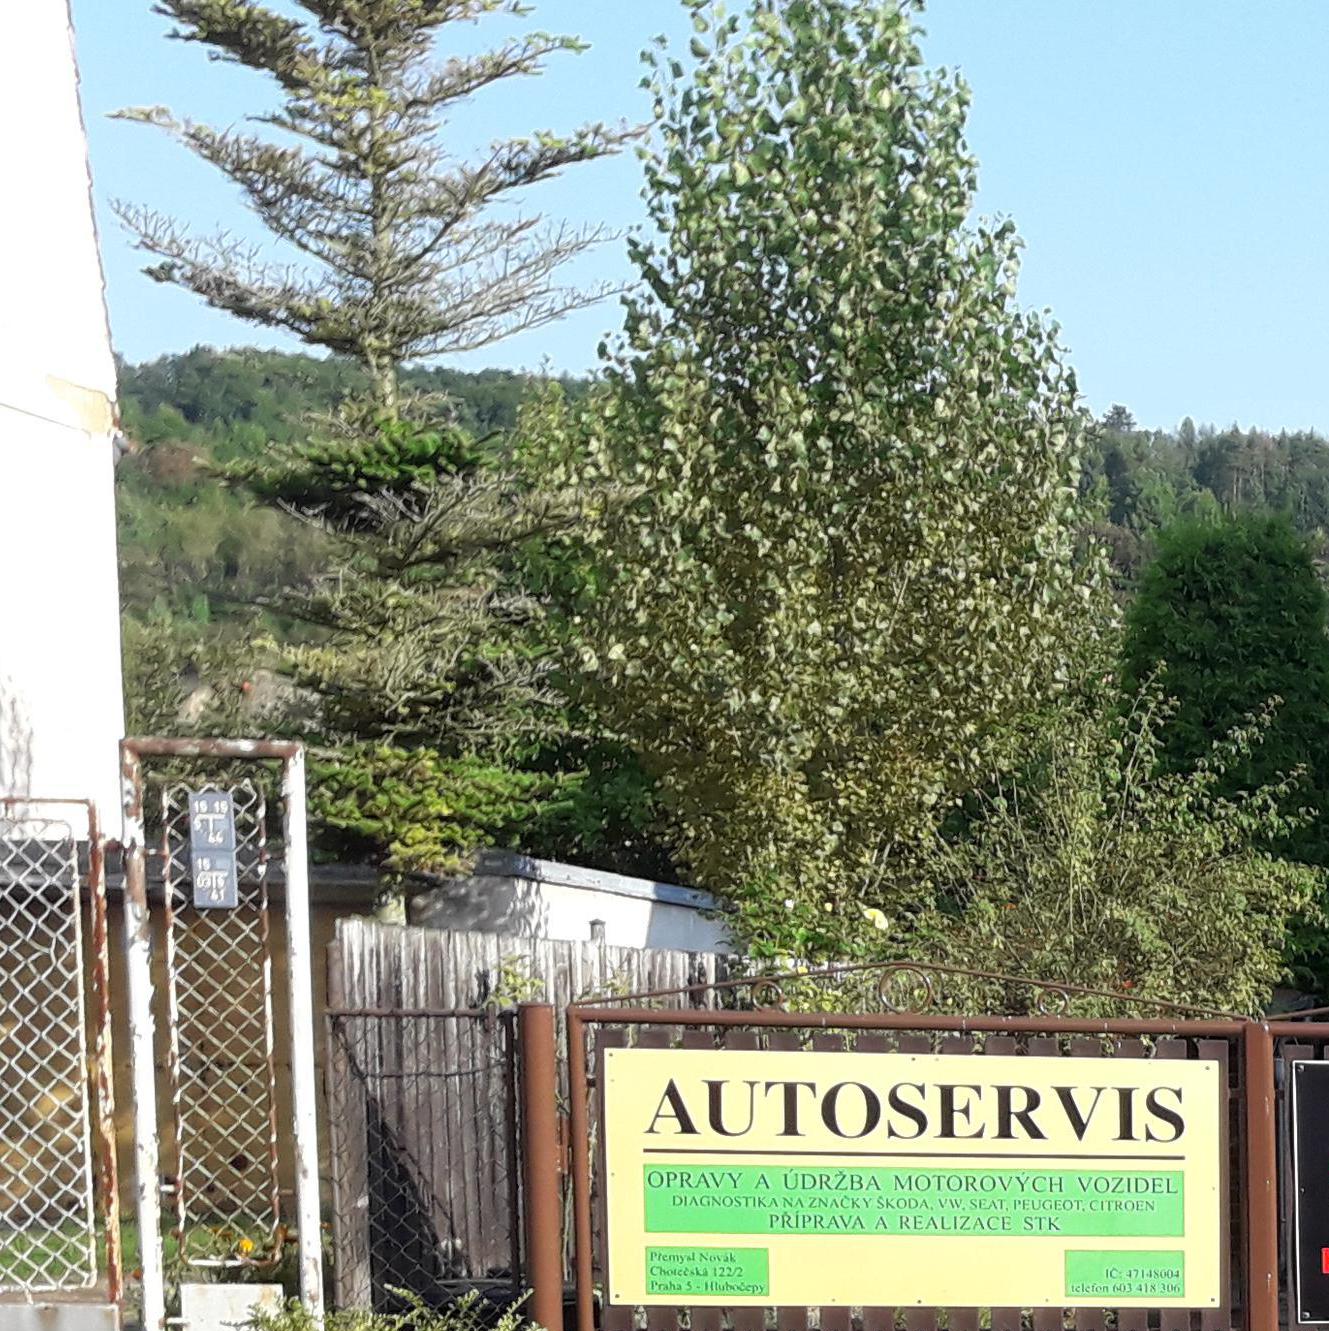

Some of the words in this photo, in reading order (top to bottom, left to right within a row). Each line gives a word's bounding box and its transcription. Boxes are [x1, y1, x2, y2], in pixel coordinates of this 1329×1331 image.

[643, 1077, 1186, 1143] AUTOSERVIS
[647, 1170, 743, 1189] OPRAVY
[754, 1173, 770, 1190] A
[783, 1168, 882, 1191] ÚDRŽBA
[893, 1171, 1064, 1194] MOTOROVÝCH
[1077, 1176, 1179, 1195] VOZIDEL
[672, 1194, 778, 1208] DIAGNOSTIKA
[782, 1196, 804, 1209] NA
[808, 1194, 872, 1210] ZNAČKY
[876, 1194, 934, 1211] ŠKODA,
[938, 1197, 966, 1212] VW,
[969, 1198, 1009, 1213] SEAT,
[1013, 1199, 1086, 1213] PEUGEOT,
[1089, 1199, 1155, 1212] CITROEN
[769, 1210, 866, 1230] PŘÍPRAVA
[874, 1215, 888, 1230] A
[899, 1215, 1012, 1231] REALIZACE
[1022, 1216, 1061, 1231] STK
[650, 1251, 695, 1264] Přemysl
[699, 1252, 736, 1263] Novák
[650, 1265, 708, 1277] Chotečská
[713, 1266, 744, 1278] 122/2
[650, 1280, 682, 1291] Praha
[686, 1280, 693, 1291] 5
[704, 1280, 765, 1294] Hlubočepy
[1070, 1282, 1109, 1293] telefon
[1112, 1283, 1132, 1293] 603
[1136, 1283, 1156, 1293] 418
